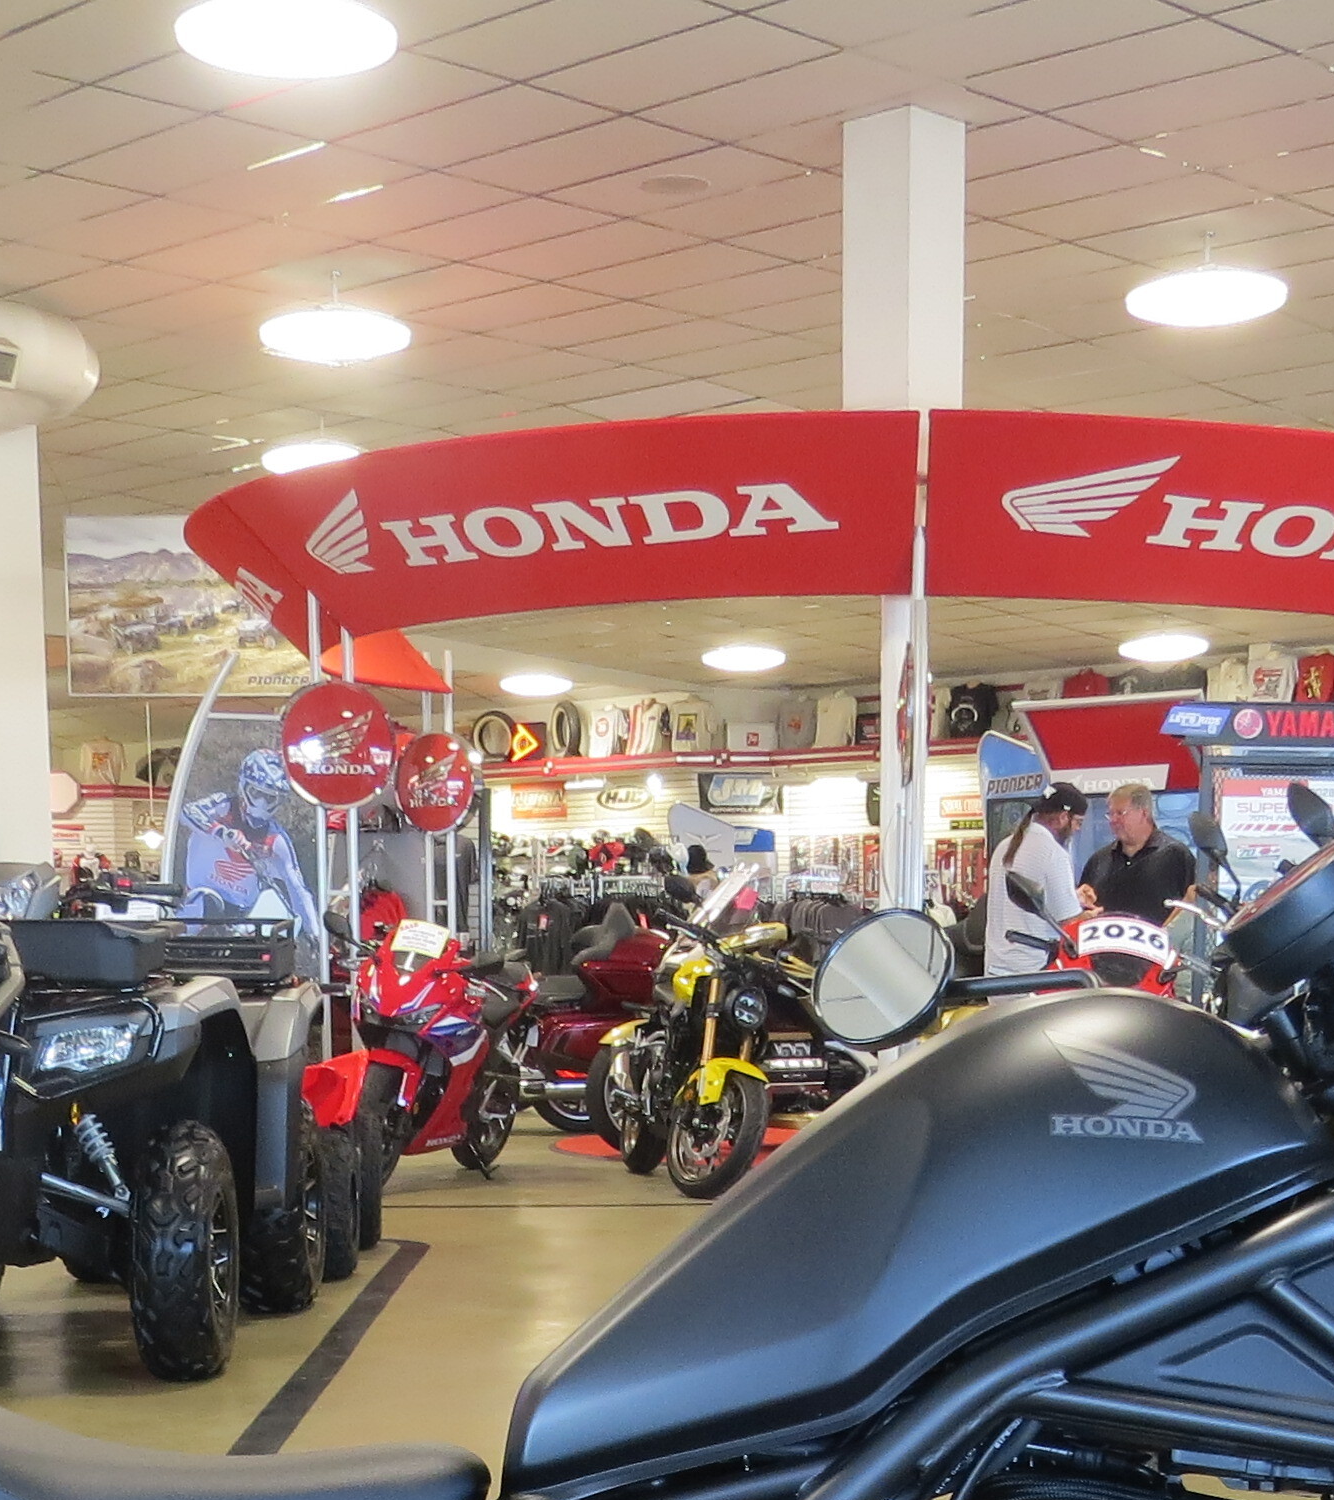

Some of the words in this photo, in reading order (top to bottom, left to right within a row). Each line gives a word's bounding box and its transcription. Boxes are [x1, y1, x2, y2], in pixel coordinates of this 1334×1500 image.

[380, 483, 840, 567] HONDA
[305, 763, 376, 775] HONDA
[604, 789, 644, 804] HJC
[987, 774, 1043, 797] PIONEER
[1082, 923, 1165, 950] 2026
[1050, 1116, 1205, 1143] HONDA
